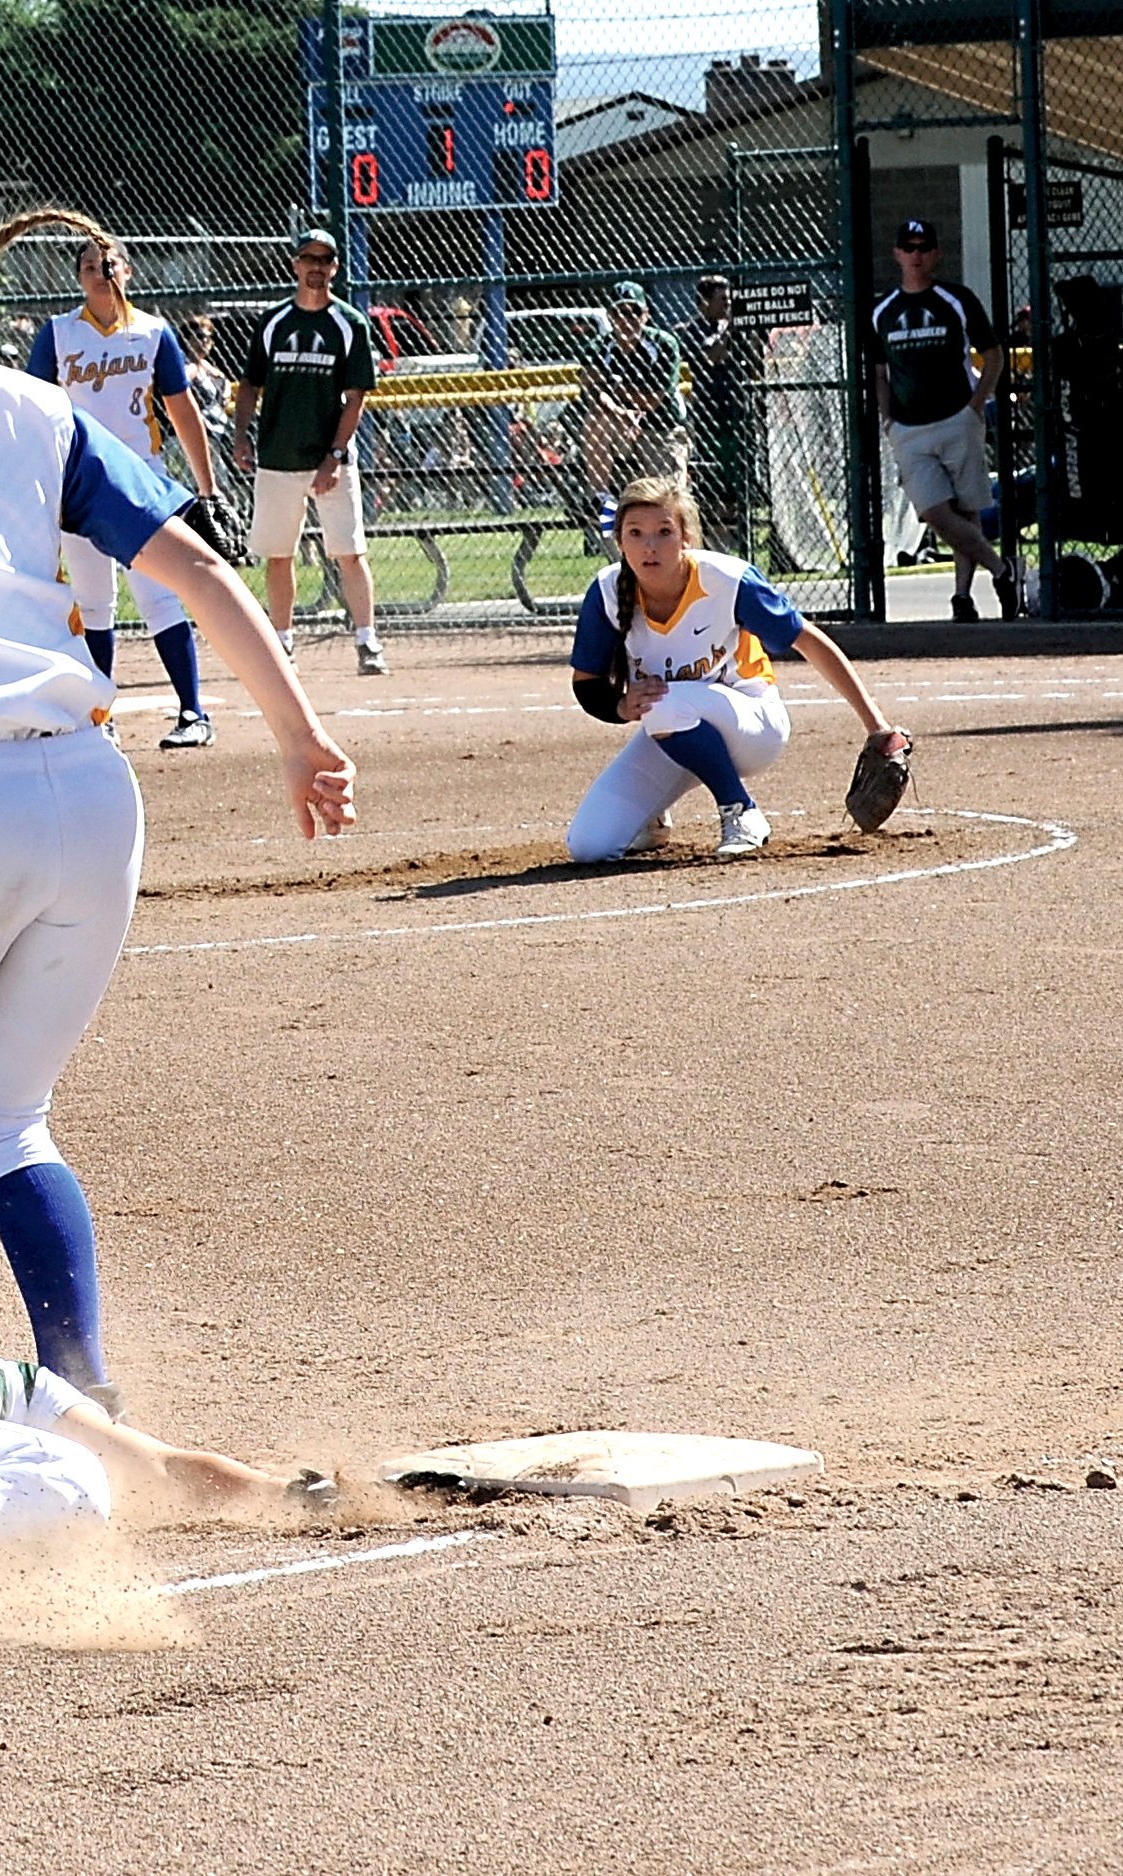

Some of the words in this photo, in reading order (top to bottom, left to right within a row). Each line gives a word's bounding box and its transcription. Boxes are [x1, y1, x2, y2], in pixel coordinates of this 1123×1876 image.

[413, 83, 464, 102] STRIKE
[503, 83, 531, 100] OUT
[317, 125, 378, 151] GEST
[494, 121, 546, 146] HOME
[443, 128, 455, 171] 1
[352, 153, 378, 205] 0
[525, 149, 550, 199] 0
[407, 181, 477, 206] INNING
[909, 221, 924, 233] PA
[732, 286, 769, 300] PLEASE
[770, 285, 785, 297] DO
[787, 284, 807, 296] NOT
[733, 315, 756, 326] INTO
[758, 313, 777, 324] THE
[779, 310, 810, 323] FENCE
[746, 301, 762, 312] HIT
[764, 299, 795, 311] BALLS
[64, 350, 148, 393] Trojans
[129, 387, 143, 416] 8
